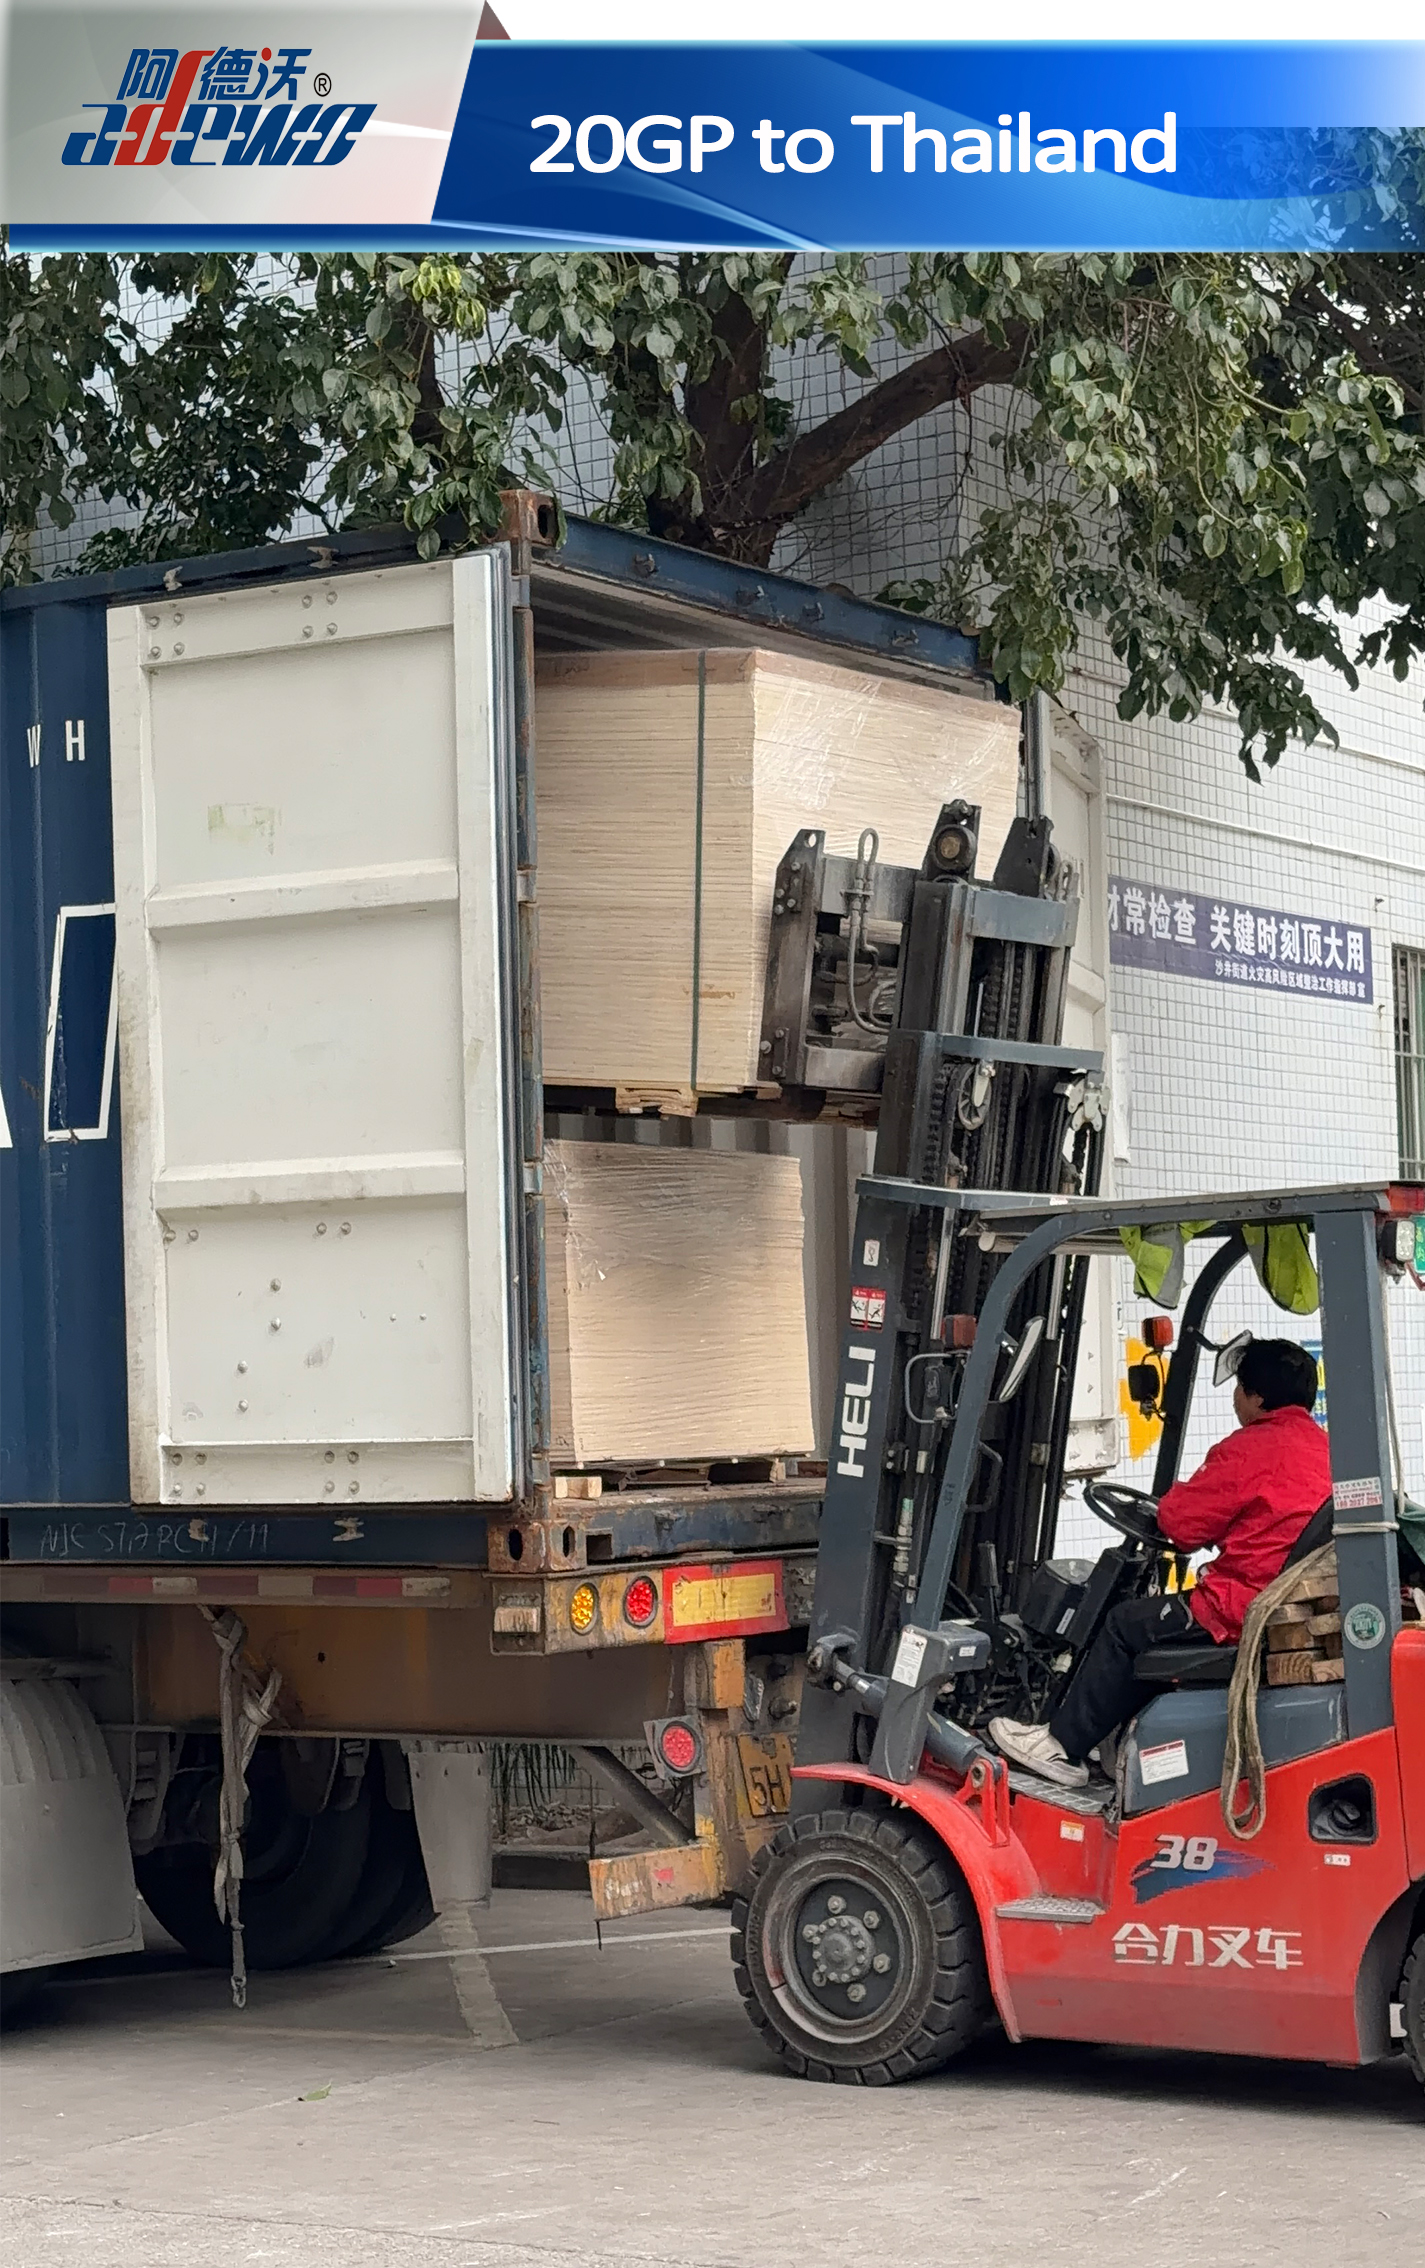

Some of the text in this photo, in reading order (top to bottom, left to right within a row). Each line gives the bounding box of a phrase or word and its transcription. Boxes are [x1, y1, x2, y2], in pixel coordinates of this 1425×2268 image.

[1210, 905, 1365, 974] 关键时刻顶大用
[837, 1345, 877, 1478] HELI
[1151, 1834, 1218, 1871] 38
[1111, 1922, 1304, 1971] 合力叉车
